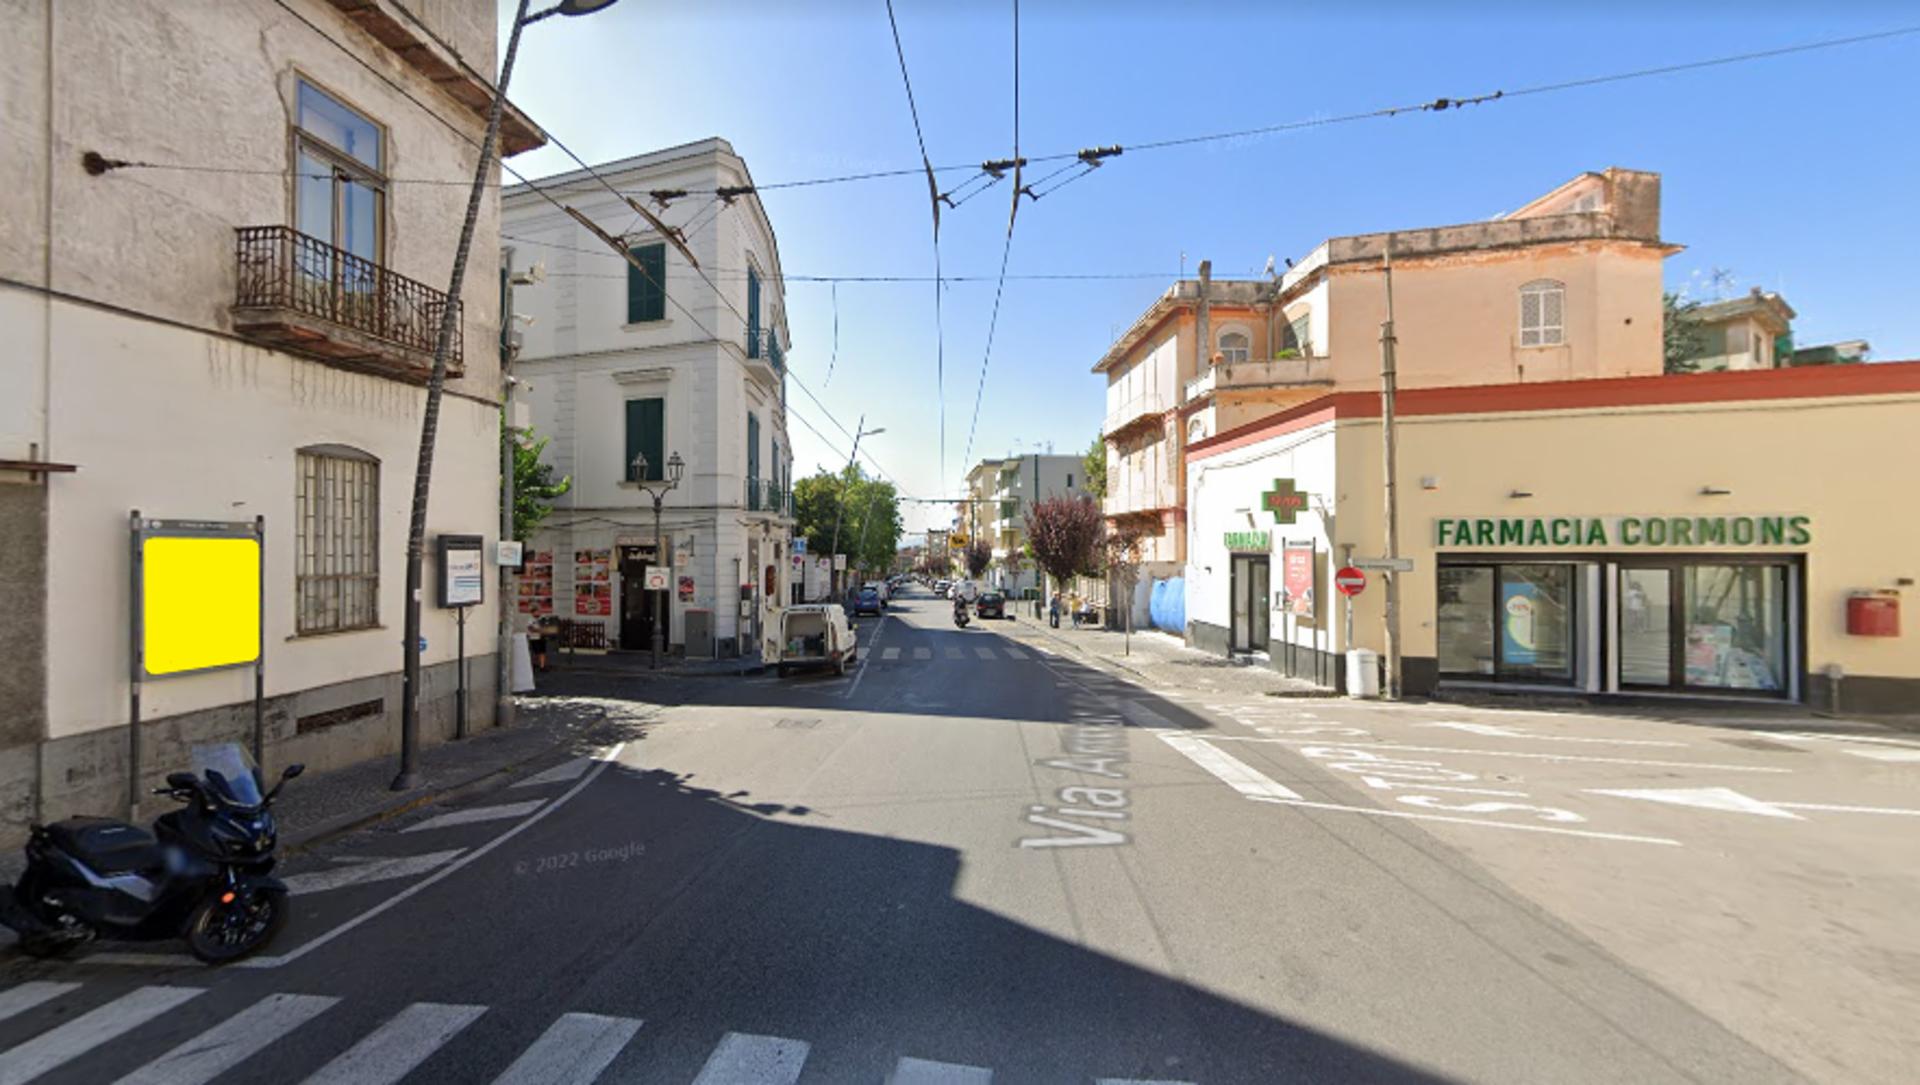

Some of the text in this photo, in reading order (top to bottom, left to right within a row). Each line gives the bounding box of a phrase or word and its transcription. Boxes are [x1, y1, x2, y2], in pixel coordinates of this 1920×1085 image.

[1437, 515, 1812, 547] FARMACIA CORMONS
[1300, 745, 1588, 823] STOP
